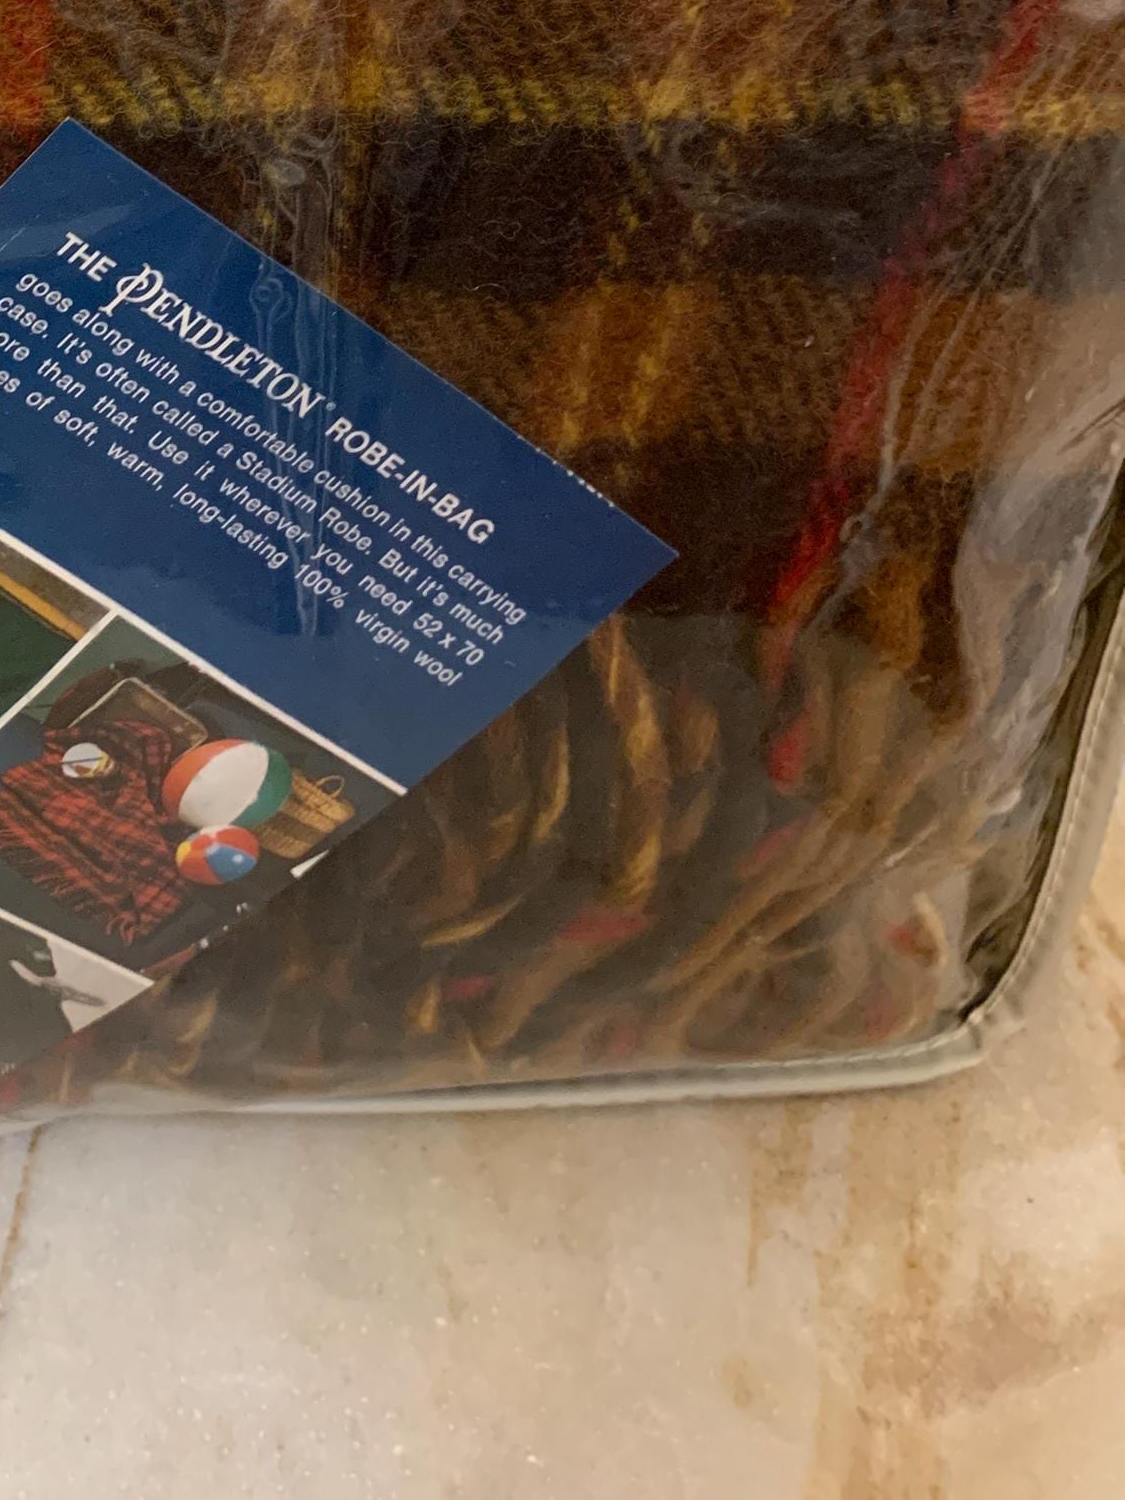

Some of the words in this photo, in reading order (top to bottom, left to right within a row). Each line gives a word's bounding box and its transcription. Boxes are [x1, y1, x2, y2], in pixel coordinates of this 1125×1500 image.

[15, 273, 74, 313] goes
[71, 308, 135, 357] along
[135, 348, 180, 385] with
[178, 380, 197, 398] a
[196, 392, 315, 473] comfortable
[313, 470, 391, 527] cushion
[388, 518, 412, 542] in
[410, 534, 449, 569] this
[447, 564, 527, 626] carrying
[25, 391, 56, 411] of
[53, 409, 99, 447] soft,
[106, 442, 164, 492] warm,
[172, 483, 289, 570] long-lasting
[294, 564, 349, 609] 100%
[355, 609, 410, 653] virgin
[413, 650, 463, 686] wool
[36, 358, 87, 399] than
[92, 395, 139, 435] that.
[147, 430, 189, 465] Use
[193, 460, 216, 481] it
[219, 478, 311, 543] wherever
[310, 543, 354, 576] you
[357, 574, 413, 616] need
[413, 612, 444, 638] 52
[437, 632, 456, 649] x
[456, 639, 485, 666] 70
[56, 231, 118, 282] THE
[324, 416, 495, 545] ROBE-IN-BAG
[56, 332, 93, 365] It's
[95, 362, 151, 404] often
[152, 400, 220, 446] called
[216, 442, 234, 459] a
[235, 451, 318, 513] Stadium
[318, 506, 373, 555] Robe.
[378, 548, 419, 583] But
[416, 575, 449, 607] it's
[449, 603, 504, 645] much
